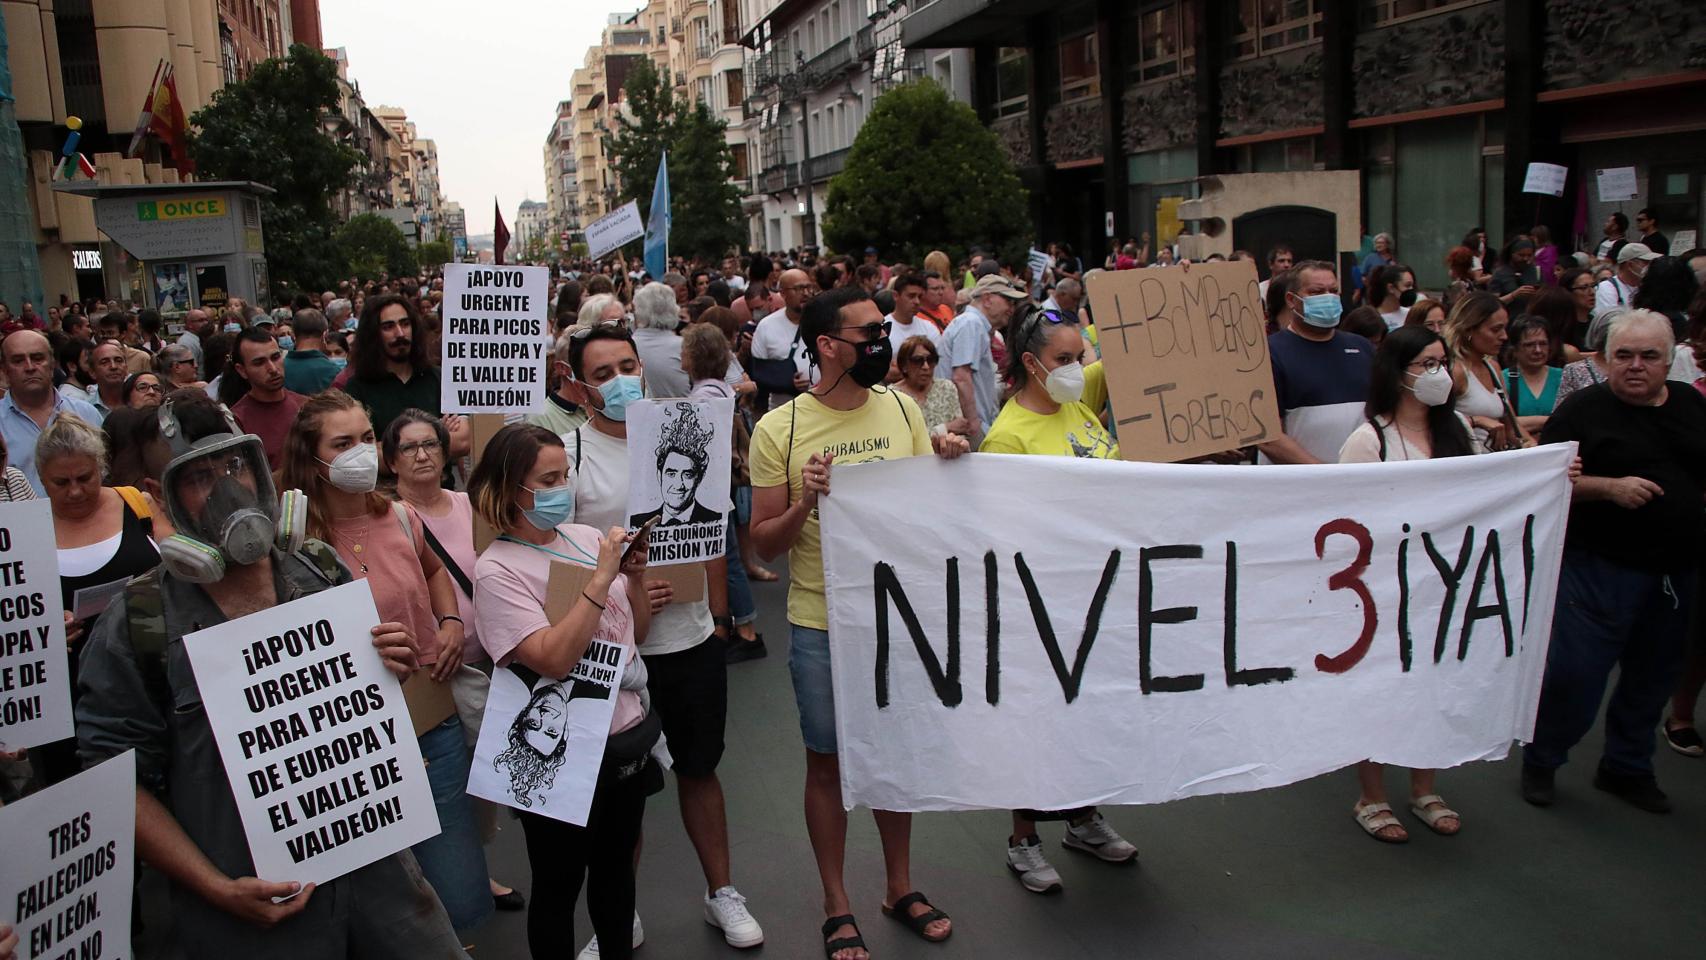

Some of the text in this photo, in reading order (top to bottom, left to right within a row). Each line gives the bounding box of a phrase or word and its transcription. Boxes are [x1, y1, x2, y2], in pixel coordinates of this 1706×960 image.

[164, 201, 218, 216] ONCE
[468, 270, 524, 288] ¡APOYO
[461, 294, 530, 312] URGENTE
[450, 318, 540, 336] PARA PICOS
[448, 342, 542, 359] DE EUROPA Y
[452, 366, 536, 382] EL VALLE DE
[458, 387, 530, 406] VALDEÓN!
[823, 437, 890, 457] RURALISMU
[628, 524, 722, 543] REZ-QUIÑONES
[648, 539, 722, 562] MISIÓN YA!
[0, 592, 45, 622] COS
[874, 540, 1295, 709] NIVEL
[1314, 518, 1380, 674] 3
[37, 625, 50, 650] Y
[242, 619, 335, 676] ¡APOYO
[20, 660, 47, 688] DE
[244, 652, 357, 713] URGENTE
[570, 662, 589, 676] RE
[238, 683, 385, 760] PARA PICOS
[248, 718, 397, 799] DE EUROPA Y
[268, 757, 403, 833] EL VALLE DE
[49, 811, 91, 860] TRES
[286, 796, 403, 864] VALDEÓN!
[16, 840, 116, 924] FALLECIDOS
[30, 892, 101, 959] EN LEÓN.
[81, 930, 102, 960] NO
